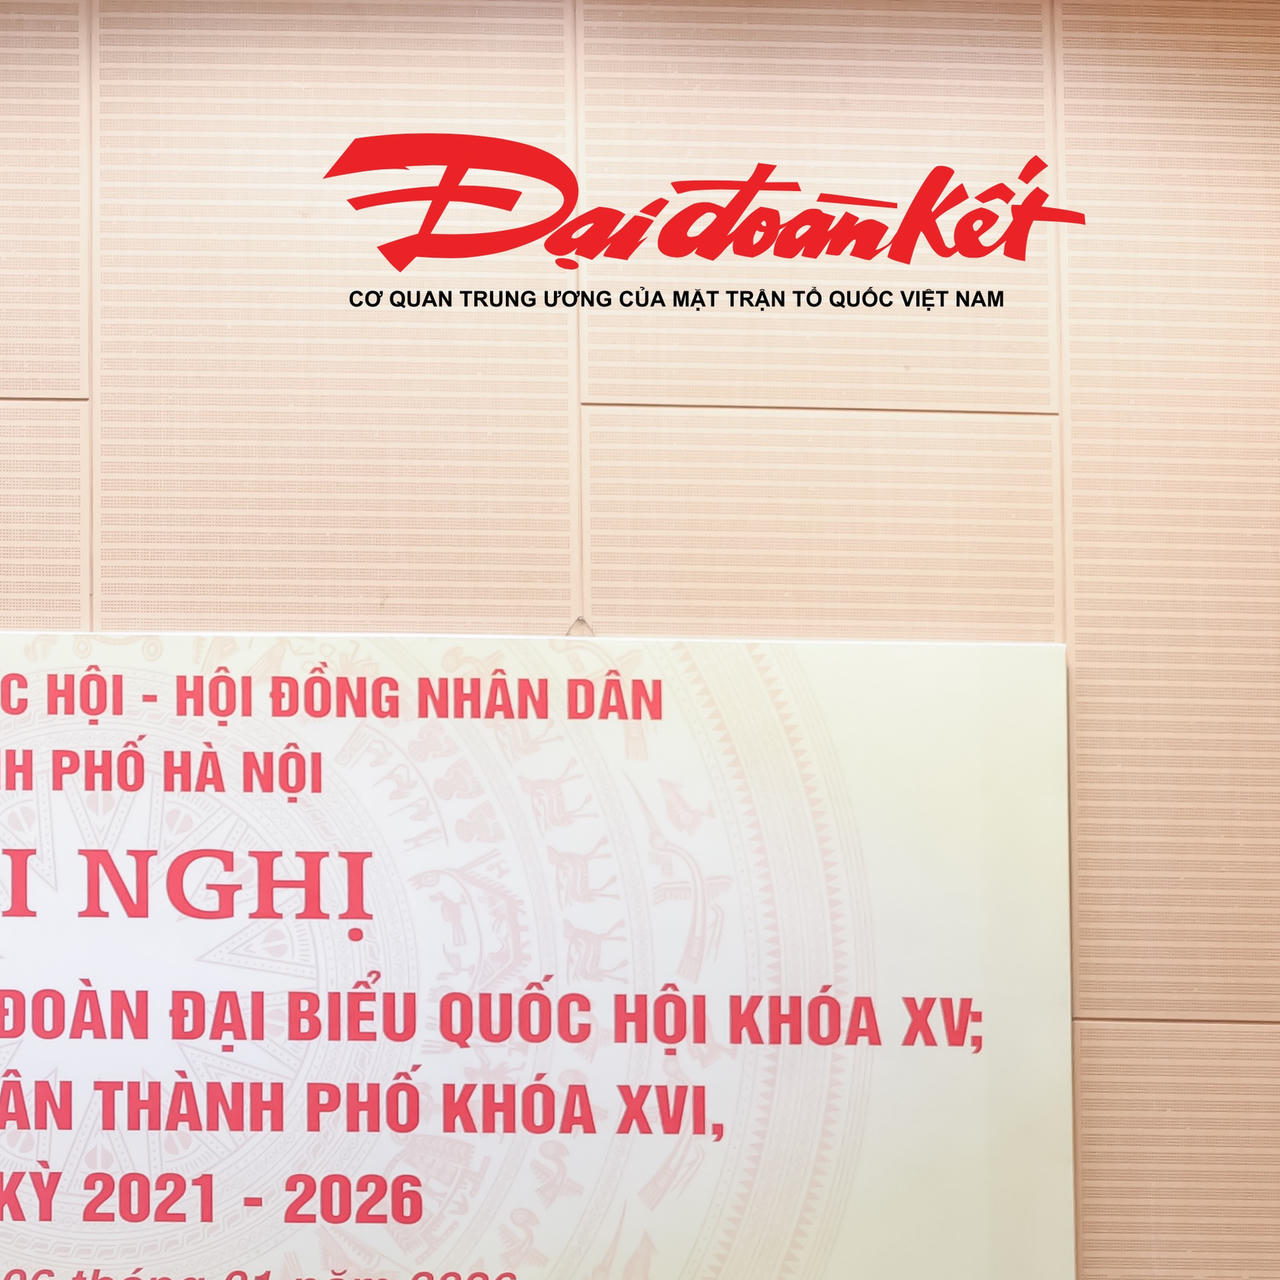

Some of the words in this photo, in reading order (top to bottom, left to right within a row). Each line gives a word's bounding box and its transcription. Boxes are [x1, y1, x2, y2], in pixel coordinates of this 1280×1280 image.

[47, 665, 124, 725] HỘI
[143, 694, 157, 702] -
[176, 667, 252, 727] HỘI
[270, 662, 399, 719] ĐỒNG
[418, 668, 548, 719] NHÂN
[567, 669, 662, 720] DÂN
[52, 735, 145, 792] PHỐ
[164, 743, 225, 793] HÀ
[243, 742, 322, 803] NỘI
[78, 849, 373, 942] NGHỊ
[169, 990, 265, 1052] ĐẠI
[288, 970, 417, 1042] BIỂU
[440, 974, 591, 1049] QUỐC
[614, 983, 706, 1055] HỘI
[730, 985, 882, 1046] KHÓA
[903, 997, 983, 1054] XV;
[94, 1070, 284, 1132] THÀNH
[307, 1064, 420, 1133] PHỐ
[443, 1073, 596, 1135] KHÓA
[617, 1085, 724, 1142] XVI,
[83, 1172, 216, 1223] 2021
[244, 1197, 263, 1207] -
[284, 1173, 423, 1225] 2026
